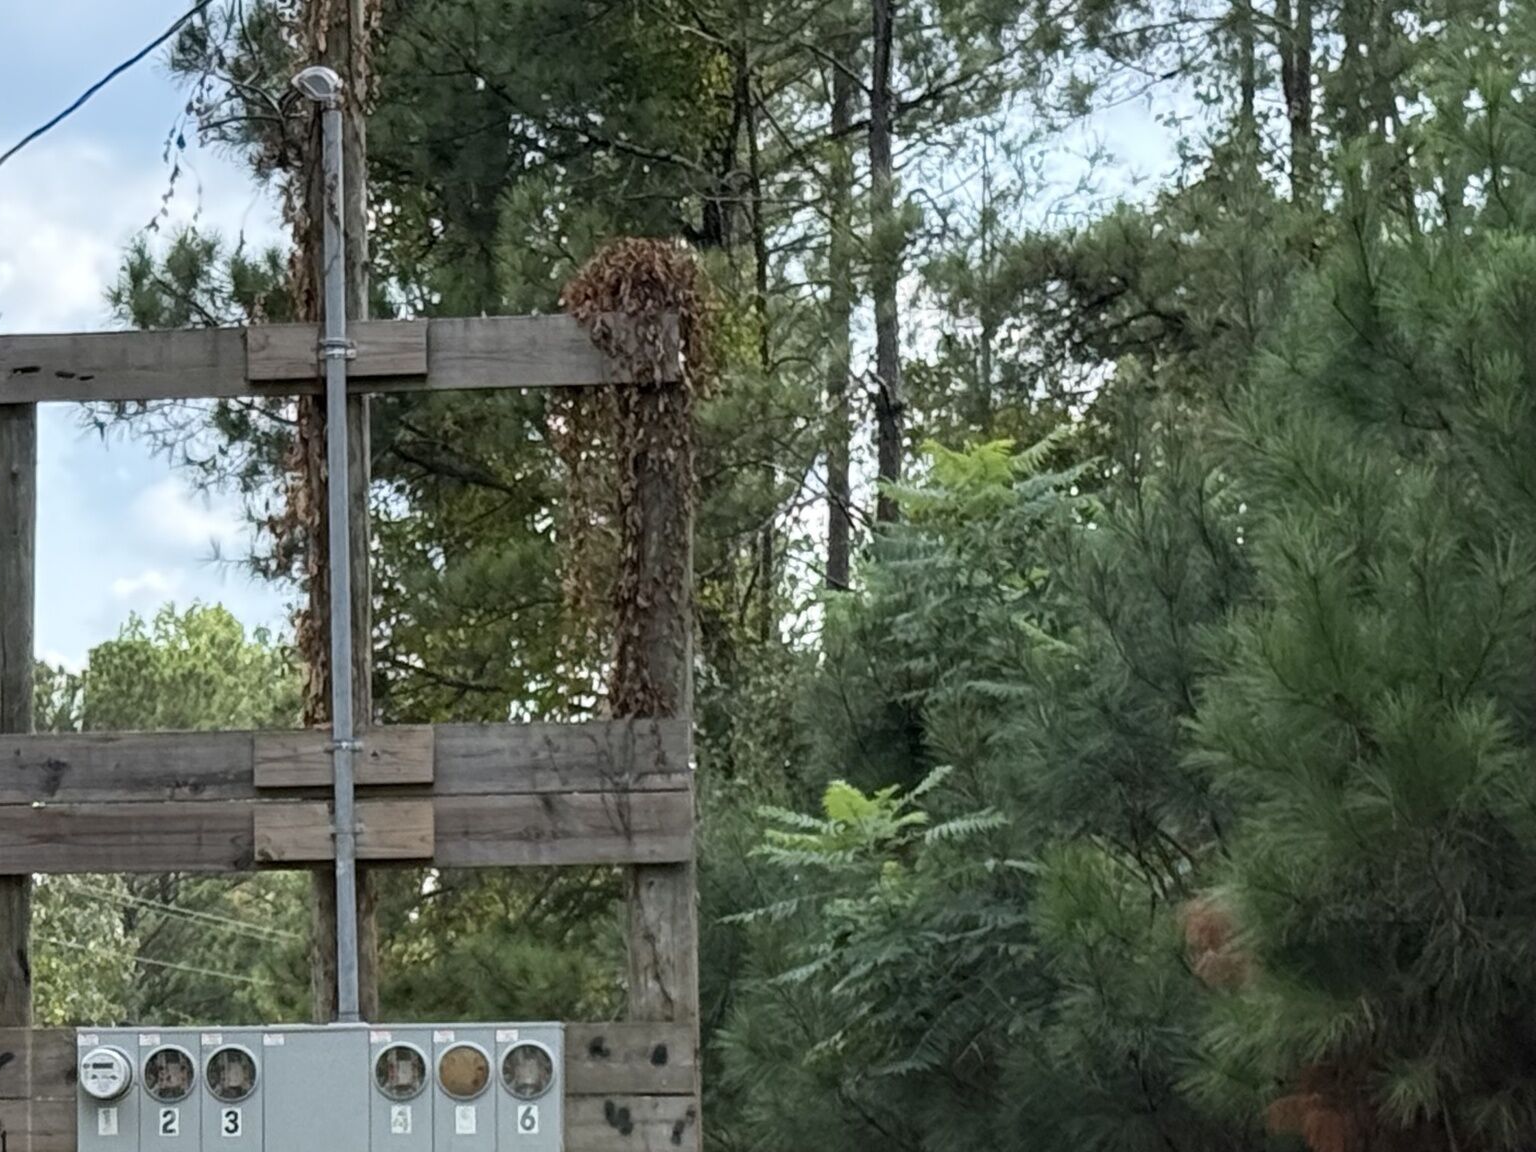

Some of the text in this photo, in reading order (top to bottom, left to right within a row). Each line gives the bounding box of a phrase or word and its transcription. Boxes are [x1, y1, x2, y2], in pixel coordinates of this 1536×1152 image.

[162, 1110, 176, 1134] 2
[224, 1110, 239, 1134] 3
[520, 1107, 536, 1131] 6
